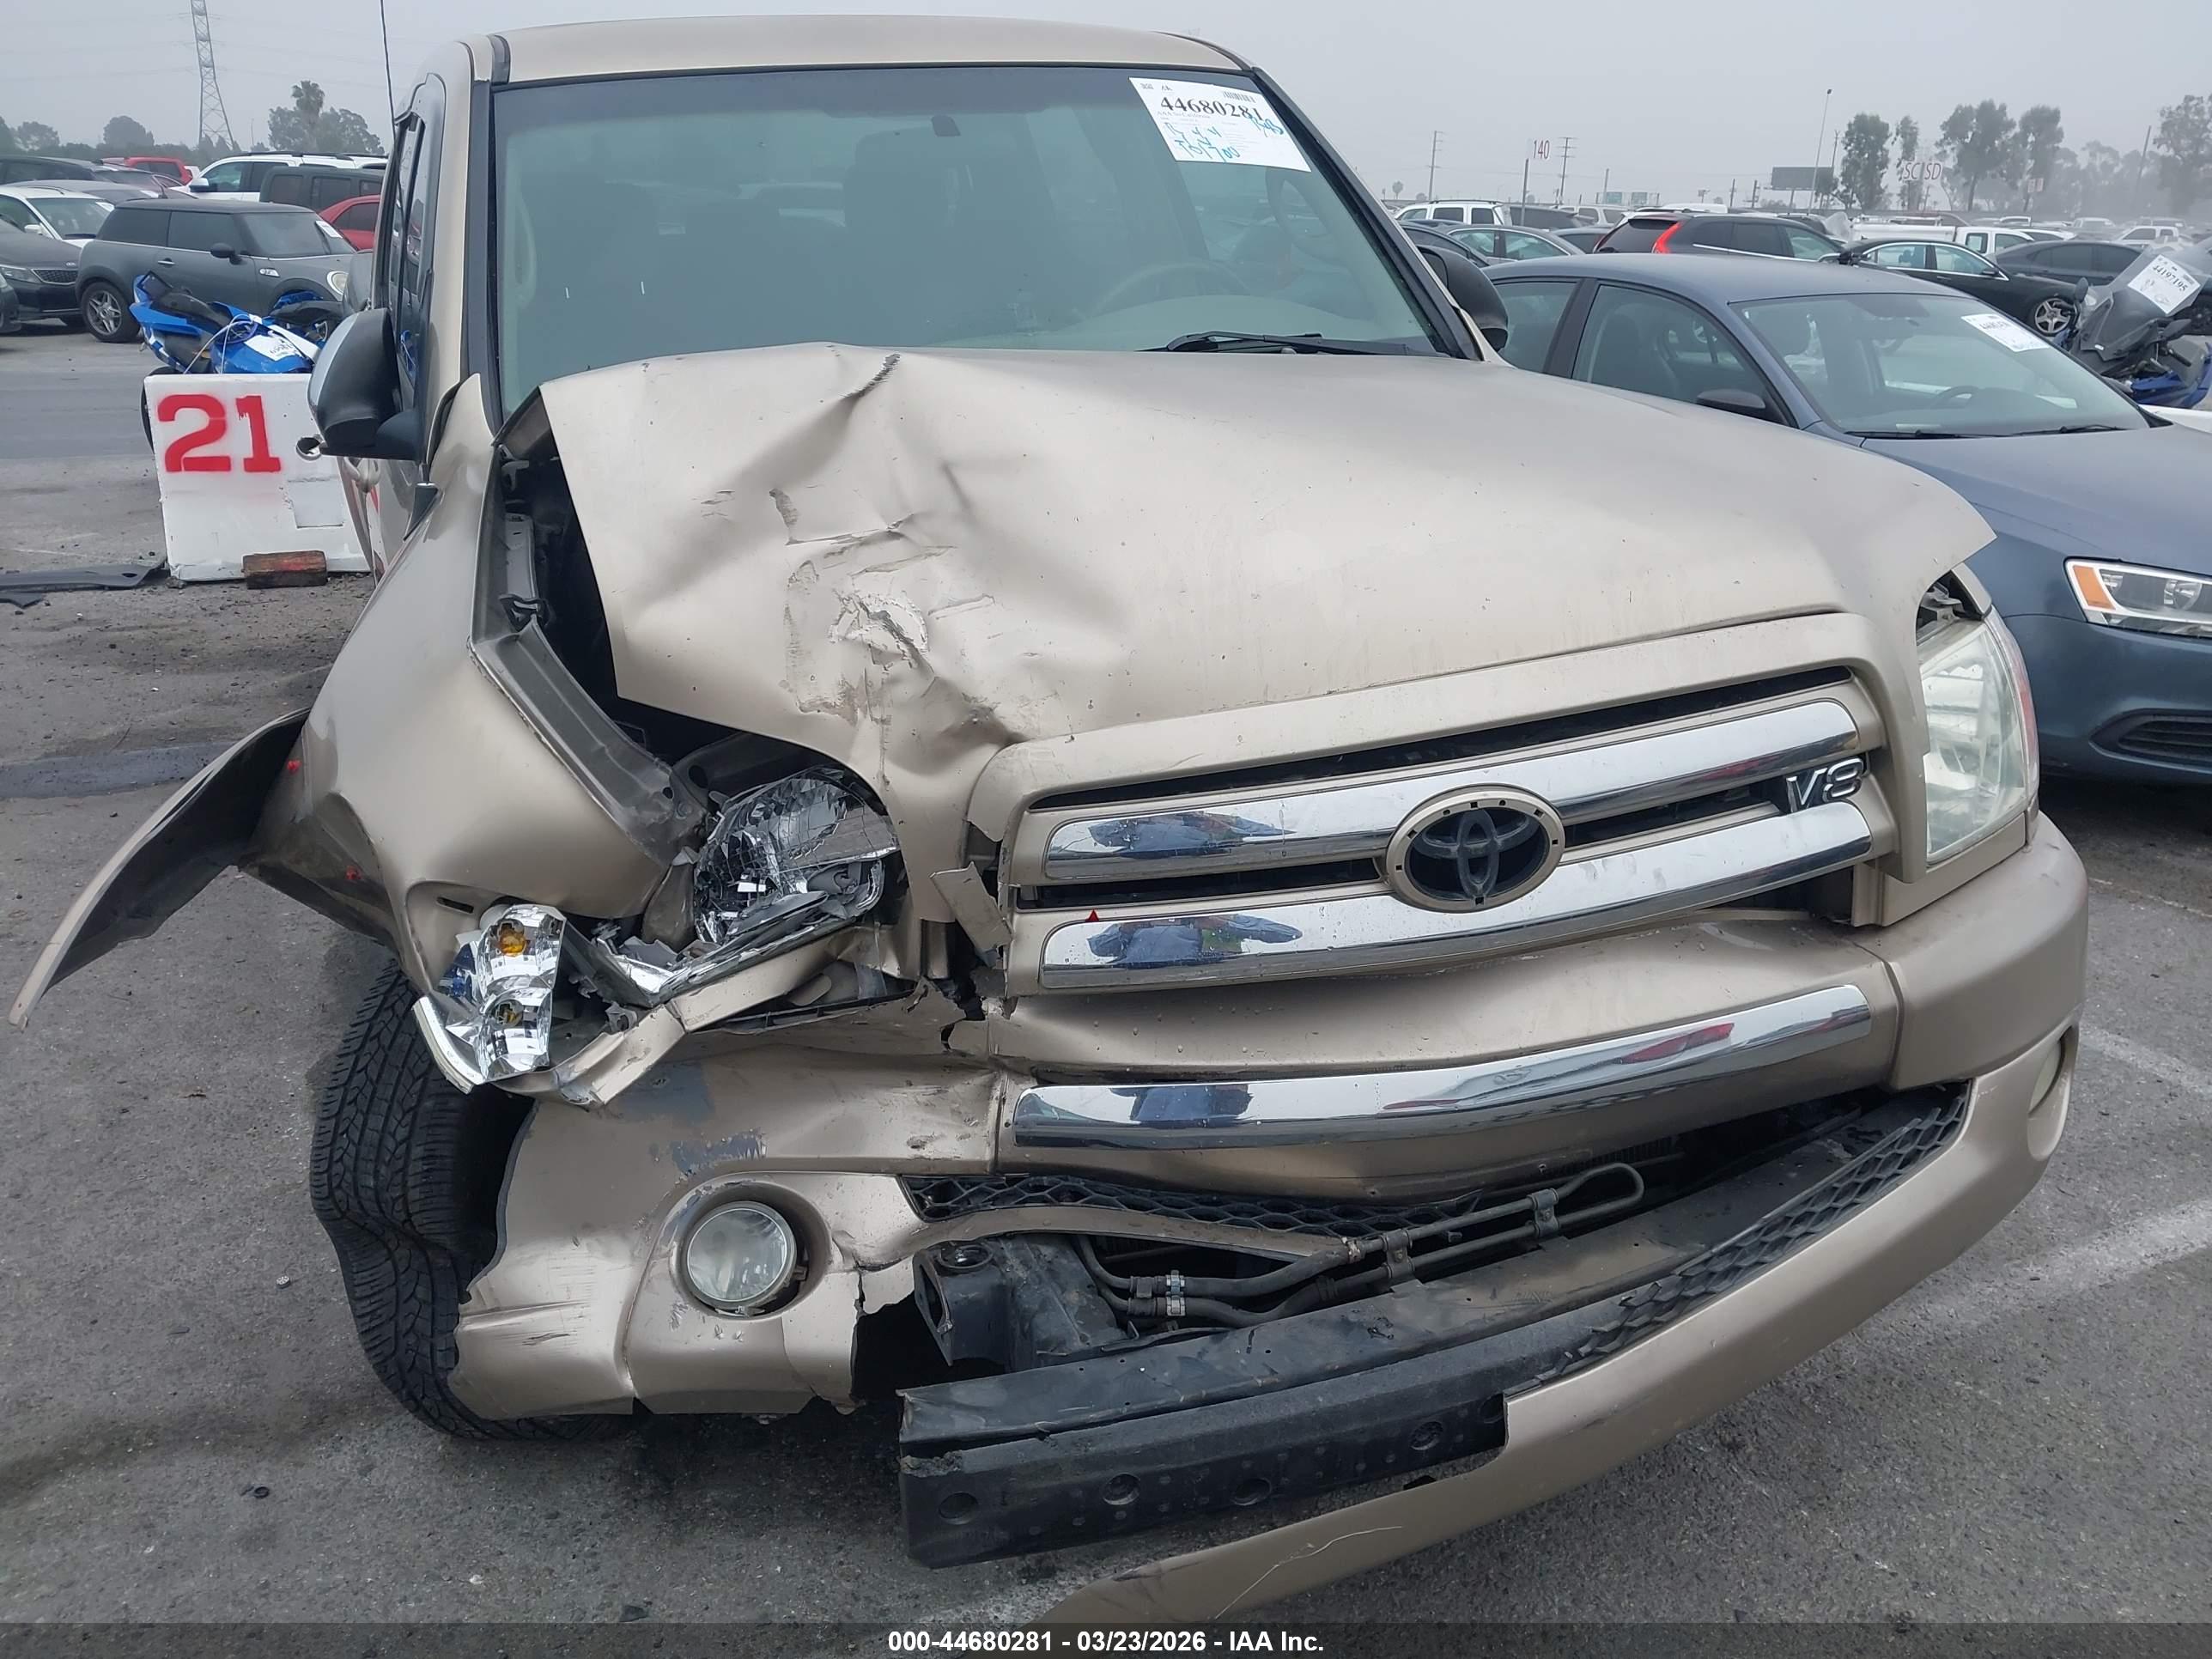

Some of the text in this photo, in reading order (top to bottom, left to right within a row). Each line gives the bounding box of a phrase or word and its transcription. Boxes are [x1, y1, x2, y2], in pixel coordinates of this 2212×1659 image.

[1161, 97, 1263, 121] 44680281
[1534, 140, 1550, 160] 140
[157, 394, 281, 472] 21
[1787, 758, 1864, 812] V8
